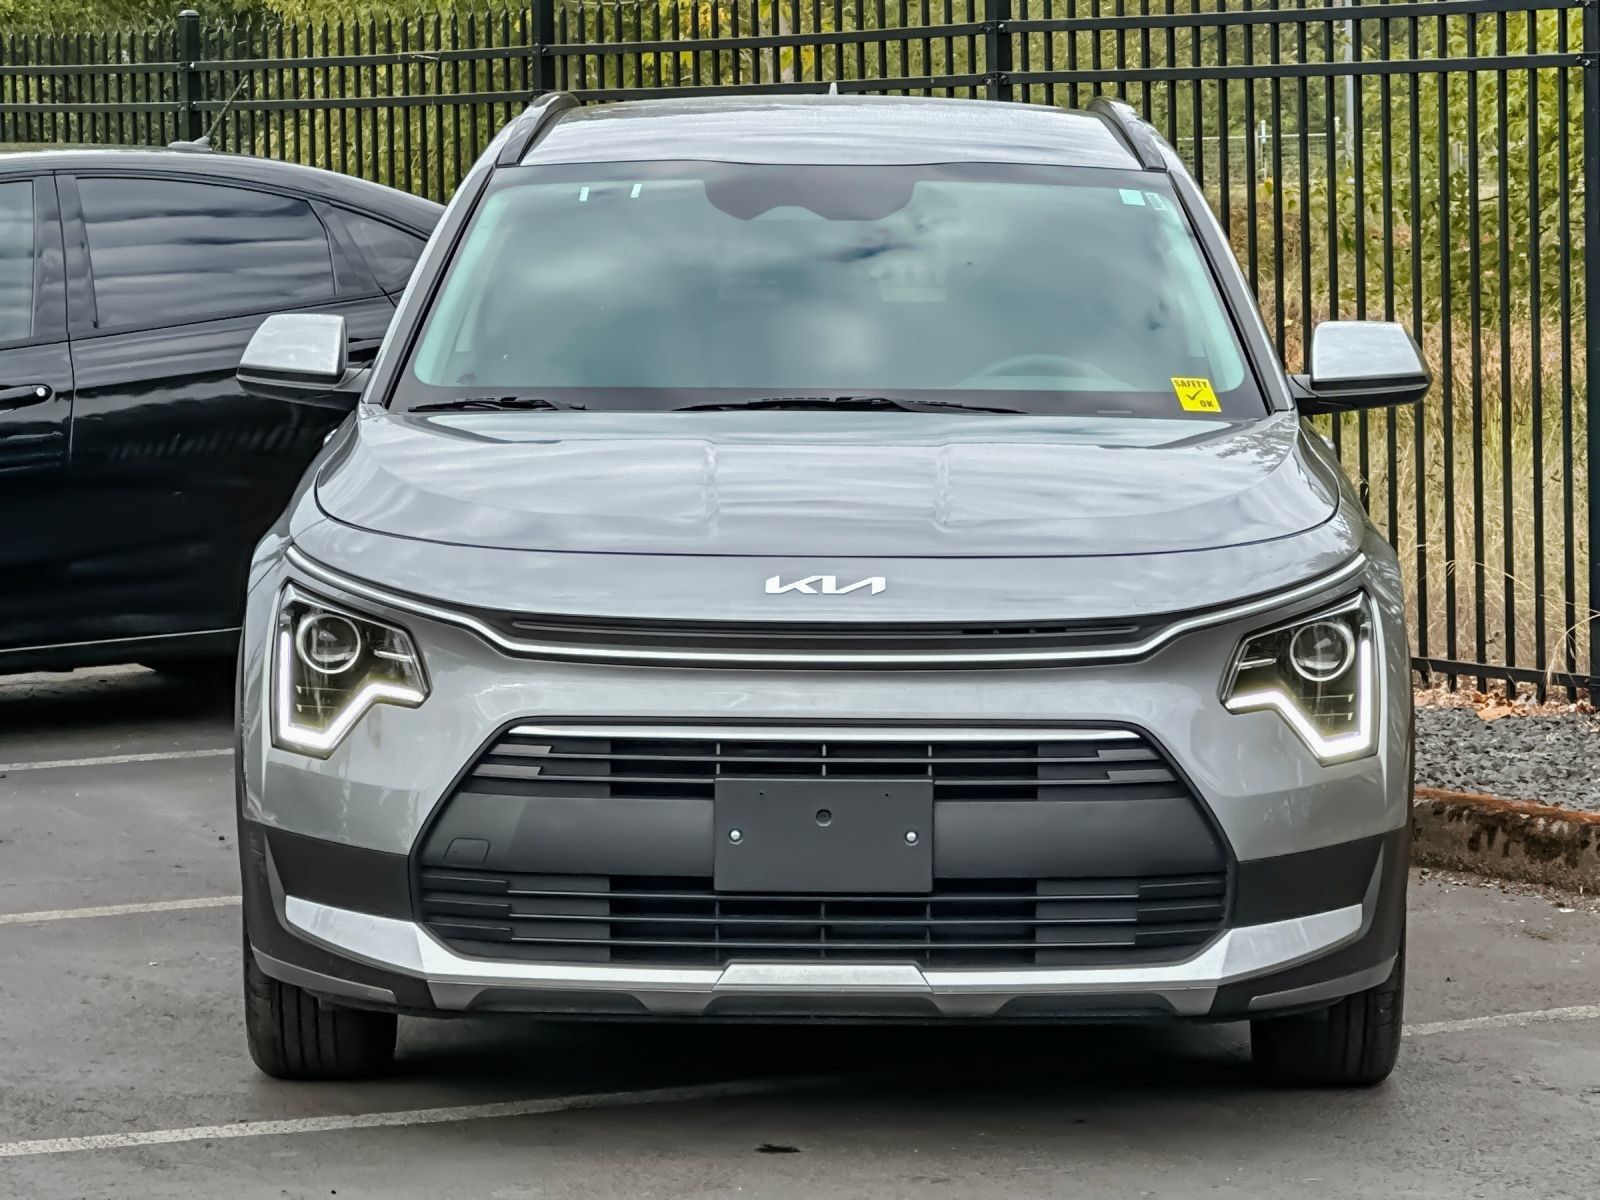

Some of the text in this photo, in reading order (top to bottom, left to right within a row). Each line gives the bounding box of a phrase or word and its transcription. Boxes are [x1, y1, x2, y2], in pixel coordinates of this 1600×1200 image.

[1173, 379, 1208, 388] SAFETY
[1200, 400, 1215, 408] OK
[765, 575, 886, 595] KIA
